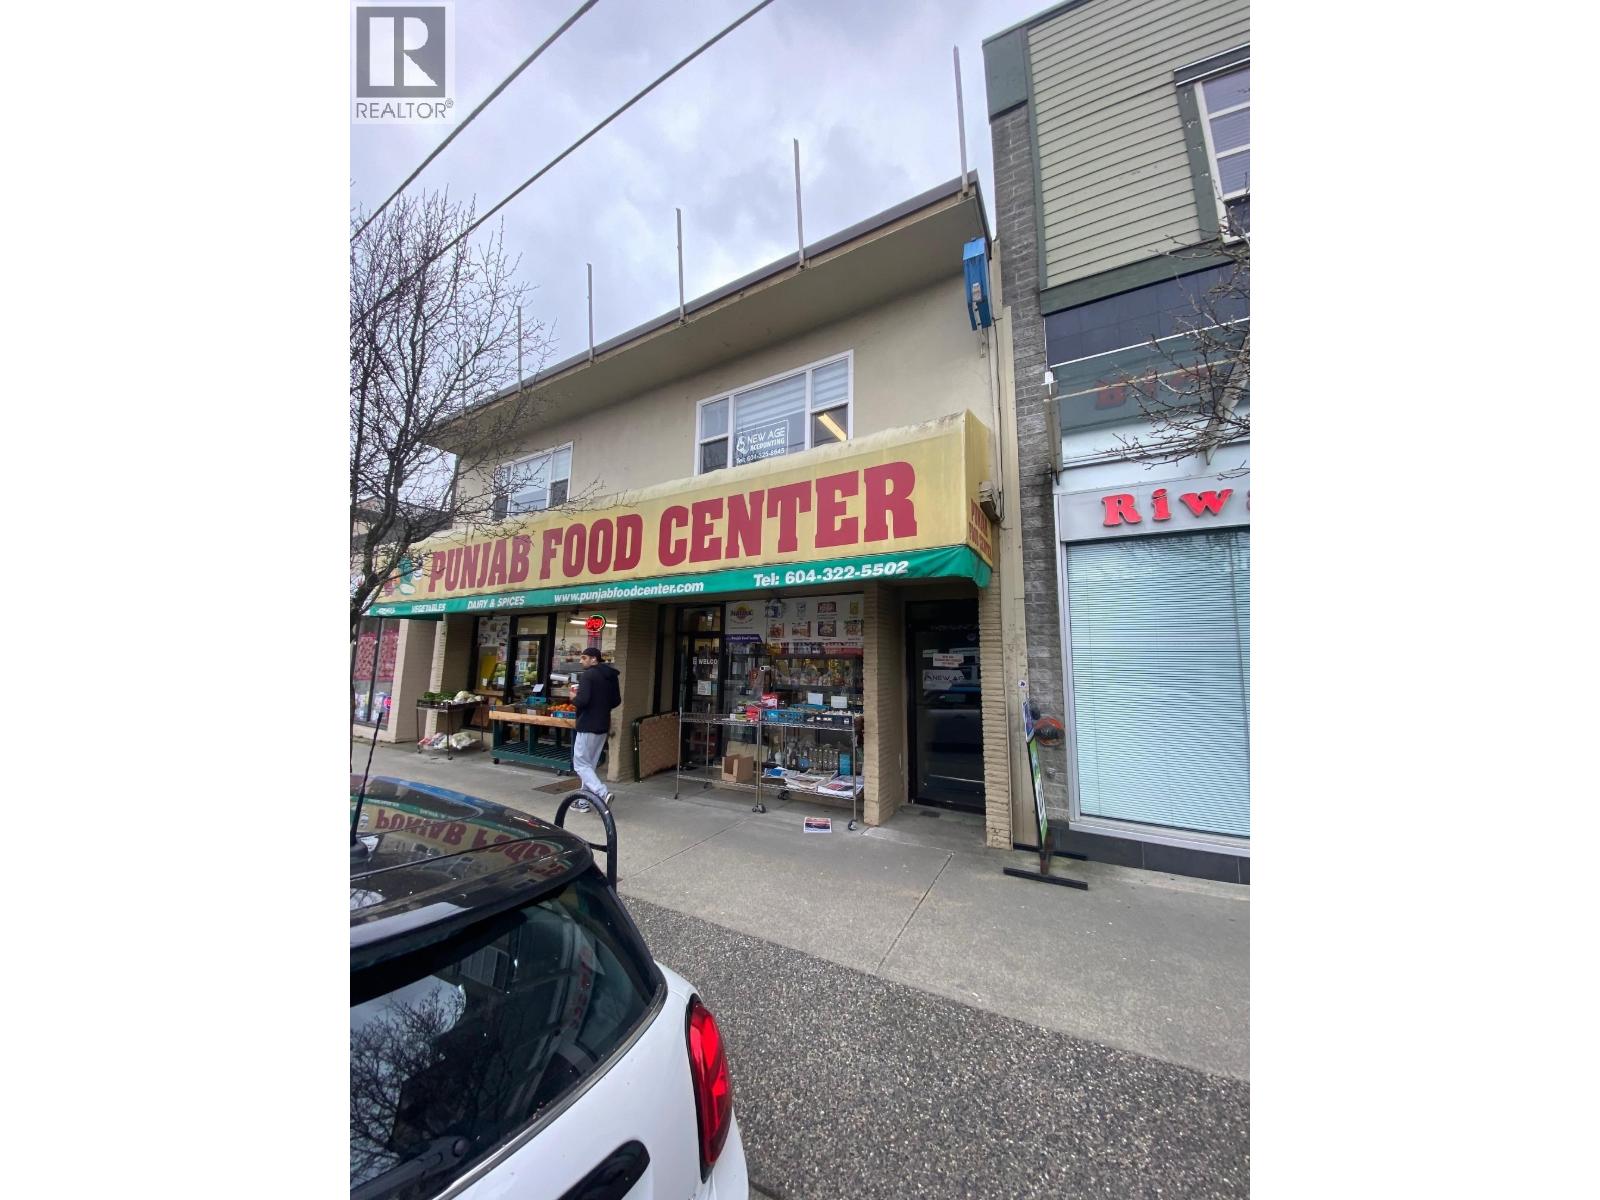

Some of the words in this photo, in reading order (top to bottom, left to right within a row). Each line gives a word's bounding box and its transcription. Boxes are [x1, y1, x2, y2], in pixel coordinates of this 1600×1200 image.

[747, 432, 766, 445] NEW
[768, 426, 786, 440] AGE
[750, 437, 785, 452] ACCOUNTING
[427, 534, 531, 593] PUNJAB
[539, 513, 644, 580] FOOD
[657, 461, 918, 568] CENTER
[1101, 487, 1250, 527] Riw
[466, 599, 488, 609] DAIRY
[489, 598, 496, 608] &
[498, 595, 526, 607] SPICES
[553, 581, 705, 603] www.punjabfoodcenter.com
[753, 572, 780, 587] Tel:
[785, 560, 910, 585] 604-322-5502
